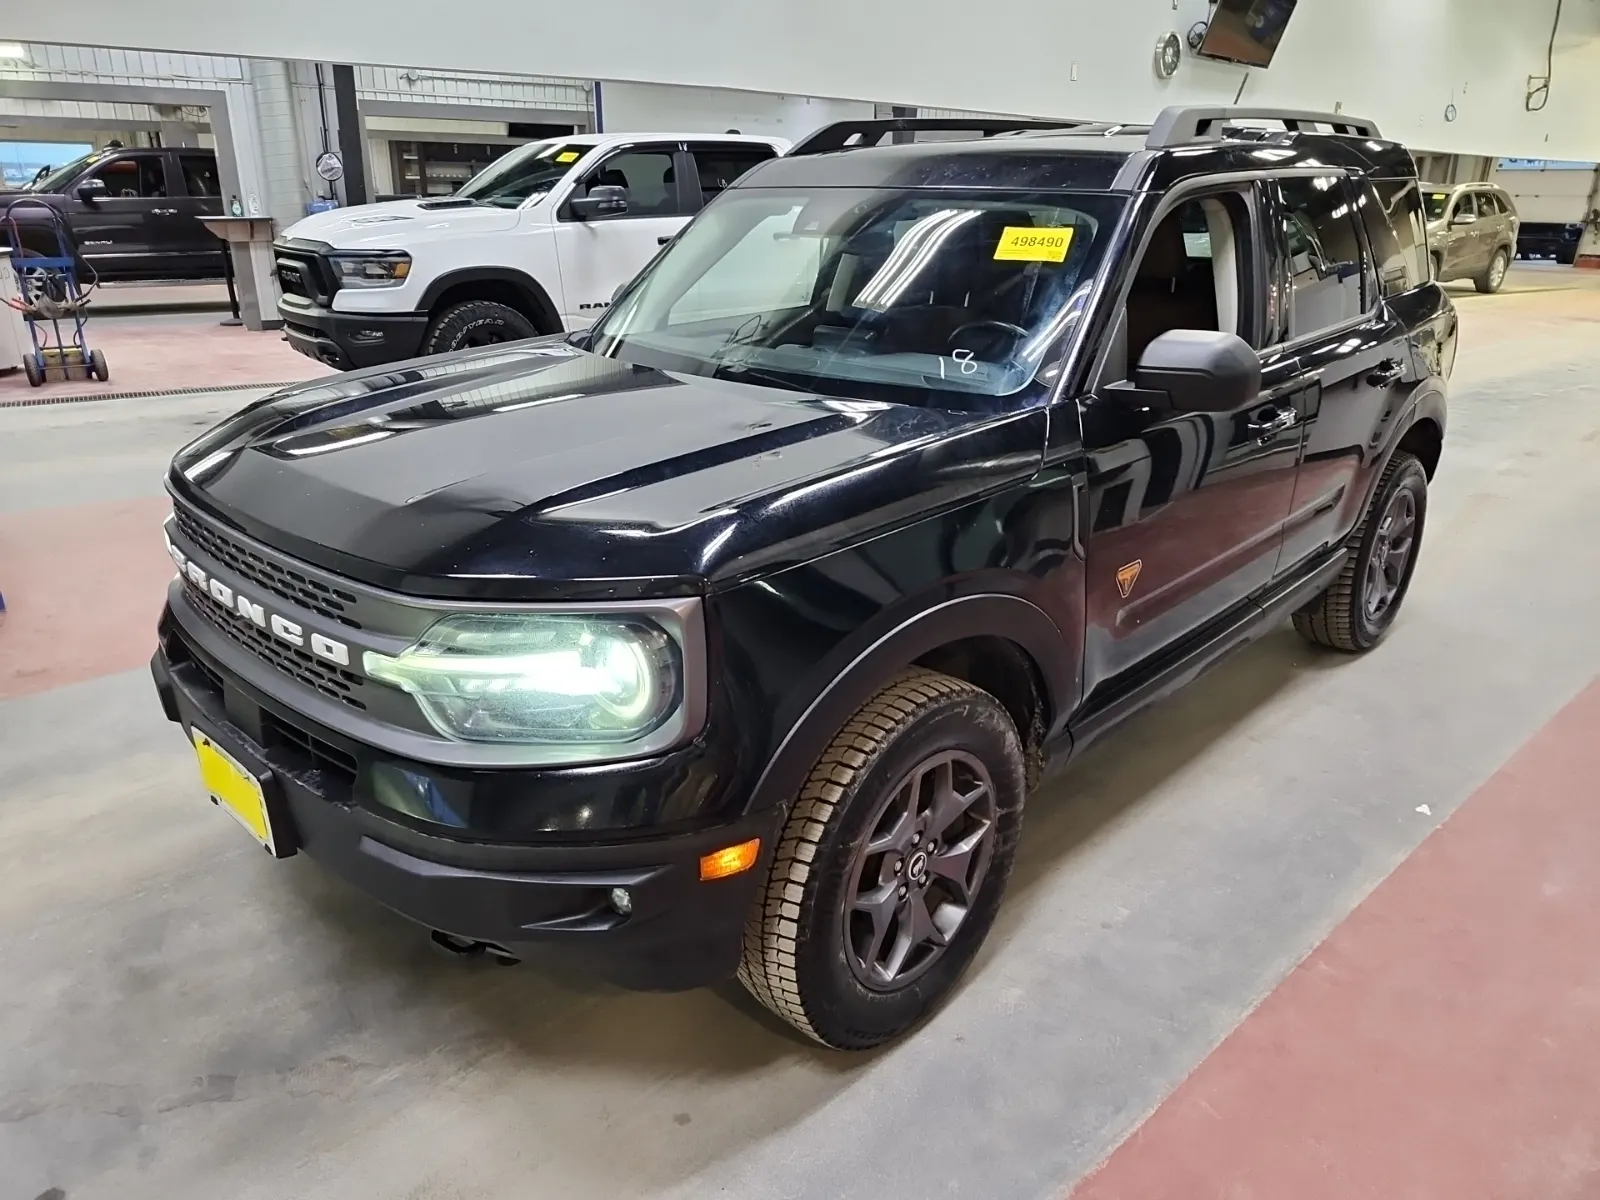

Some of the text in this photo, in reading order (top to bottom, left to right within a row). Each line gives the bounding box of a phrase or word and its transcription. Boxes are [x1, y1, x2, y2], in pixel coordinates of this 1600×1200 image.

[1010, 236, 1064, 248] 498490
[938, 348, 978, 380] 18
[171, 544, 351, 666] BRONCO
